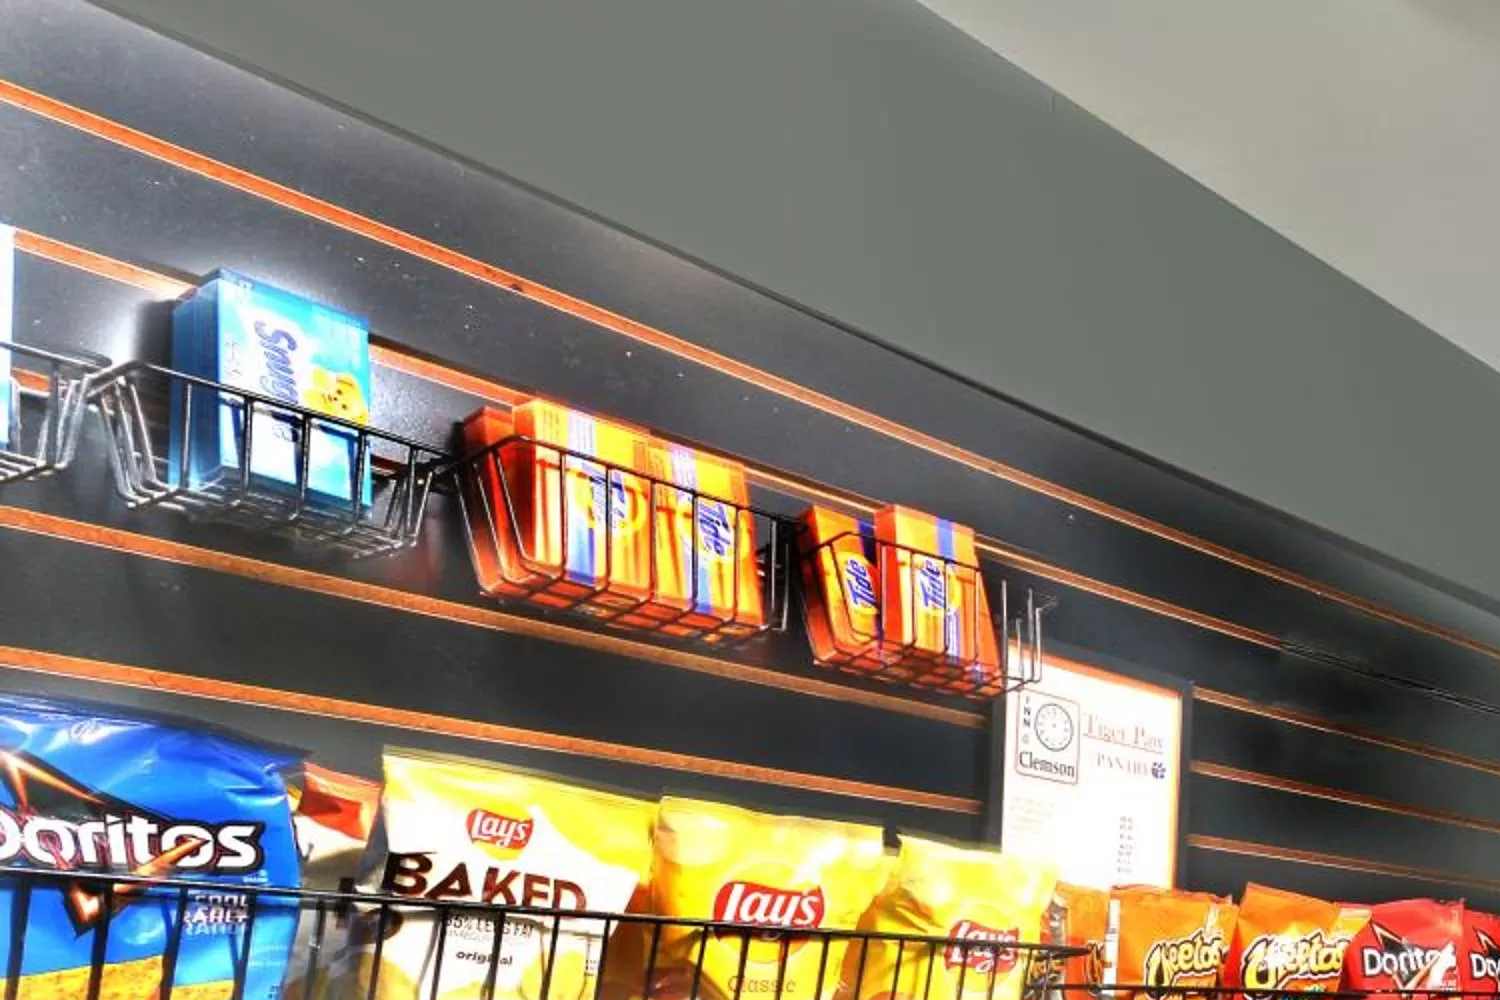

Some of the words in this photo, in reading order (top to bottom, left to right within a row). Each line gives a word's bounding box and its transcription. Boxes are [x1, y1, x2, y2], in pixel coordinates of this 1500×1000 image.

[846, 559, 876, 608] Tide
[920, 560, 945, 609] Tide
[1019, 751, 1075, 777] Clemson
[471, 811, 528, 848] Lay's
[381, 851, 588, 919] BAKED
[724, 882, 820, 939] Lay's
[456, 951, 513, 965] origial
[1363, 945, 1456, 977] Dorito
[728, 976, 797, 993] Cassc
